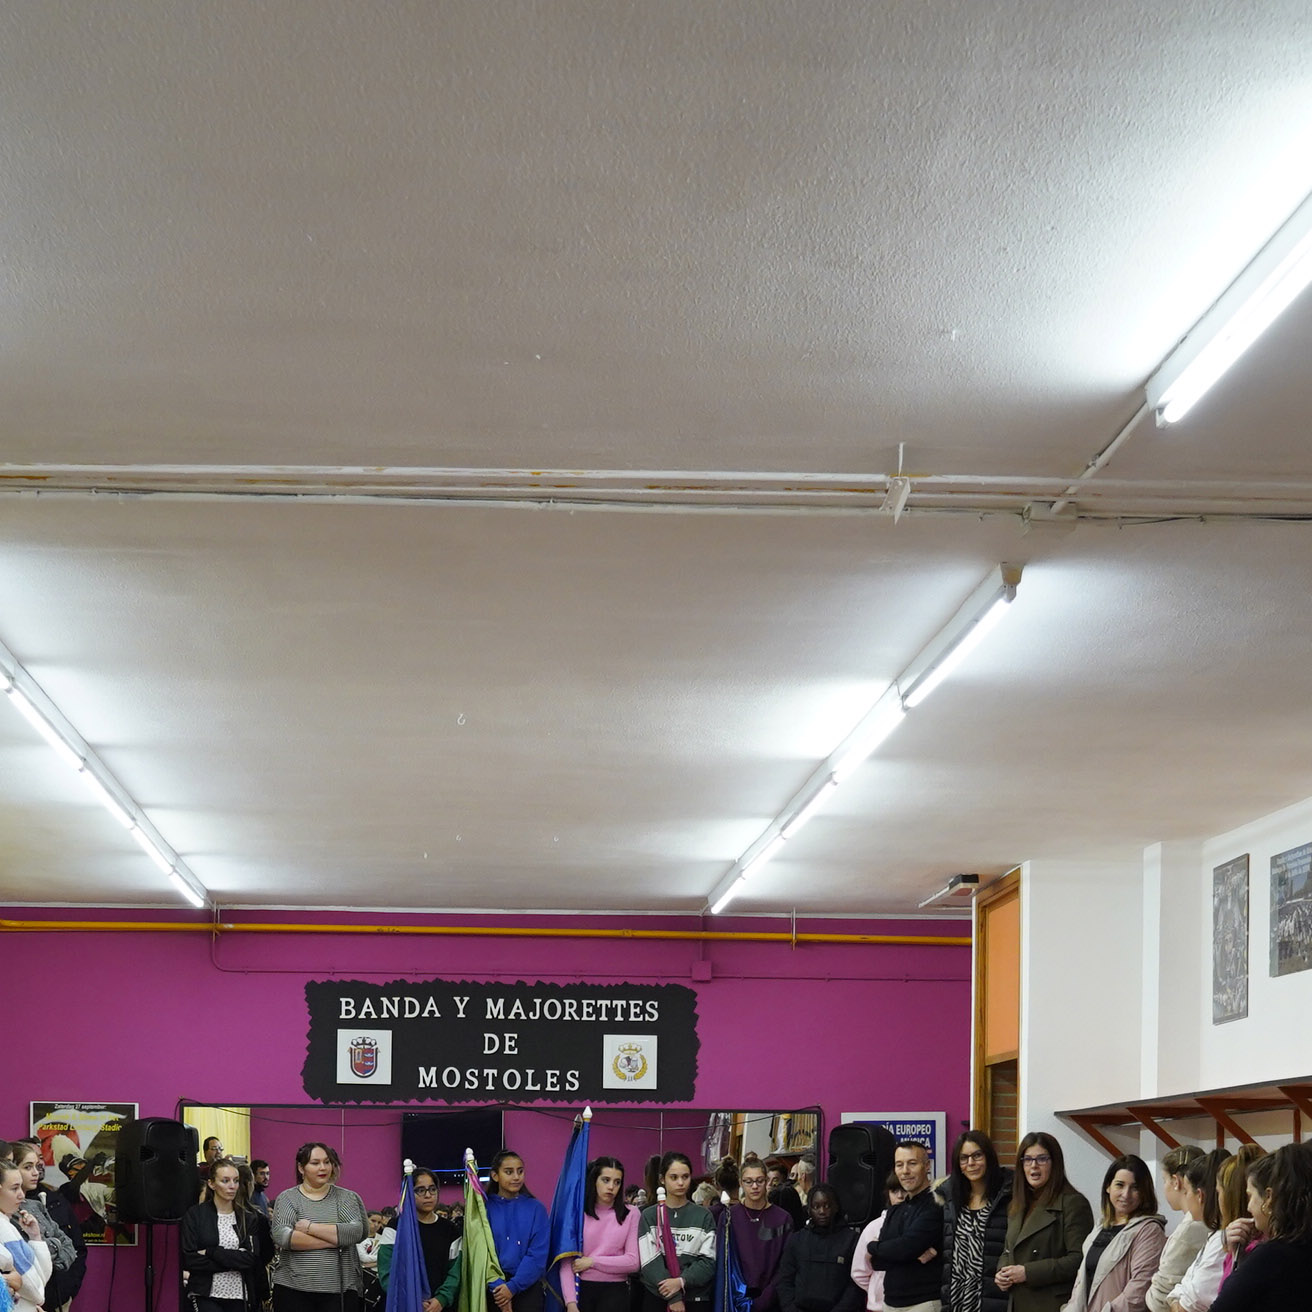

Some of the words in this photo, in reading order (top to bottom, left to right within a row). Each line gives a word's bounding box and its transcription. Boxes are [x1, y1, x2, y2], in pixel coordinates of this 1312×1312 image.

[339, 996, 442, 1020] BANDA
[453, 996, 470, 1019] Y
[485, 998, 660, 1023] MAJORETTES
[483, 1033, 519, 1055] DE
[418, 1066, 581, 1091] MOSTOLES
[895, 1124, 932, 1135] EUROPEO
